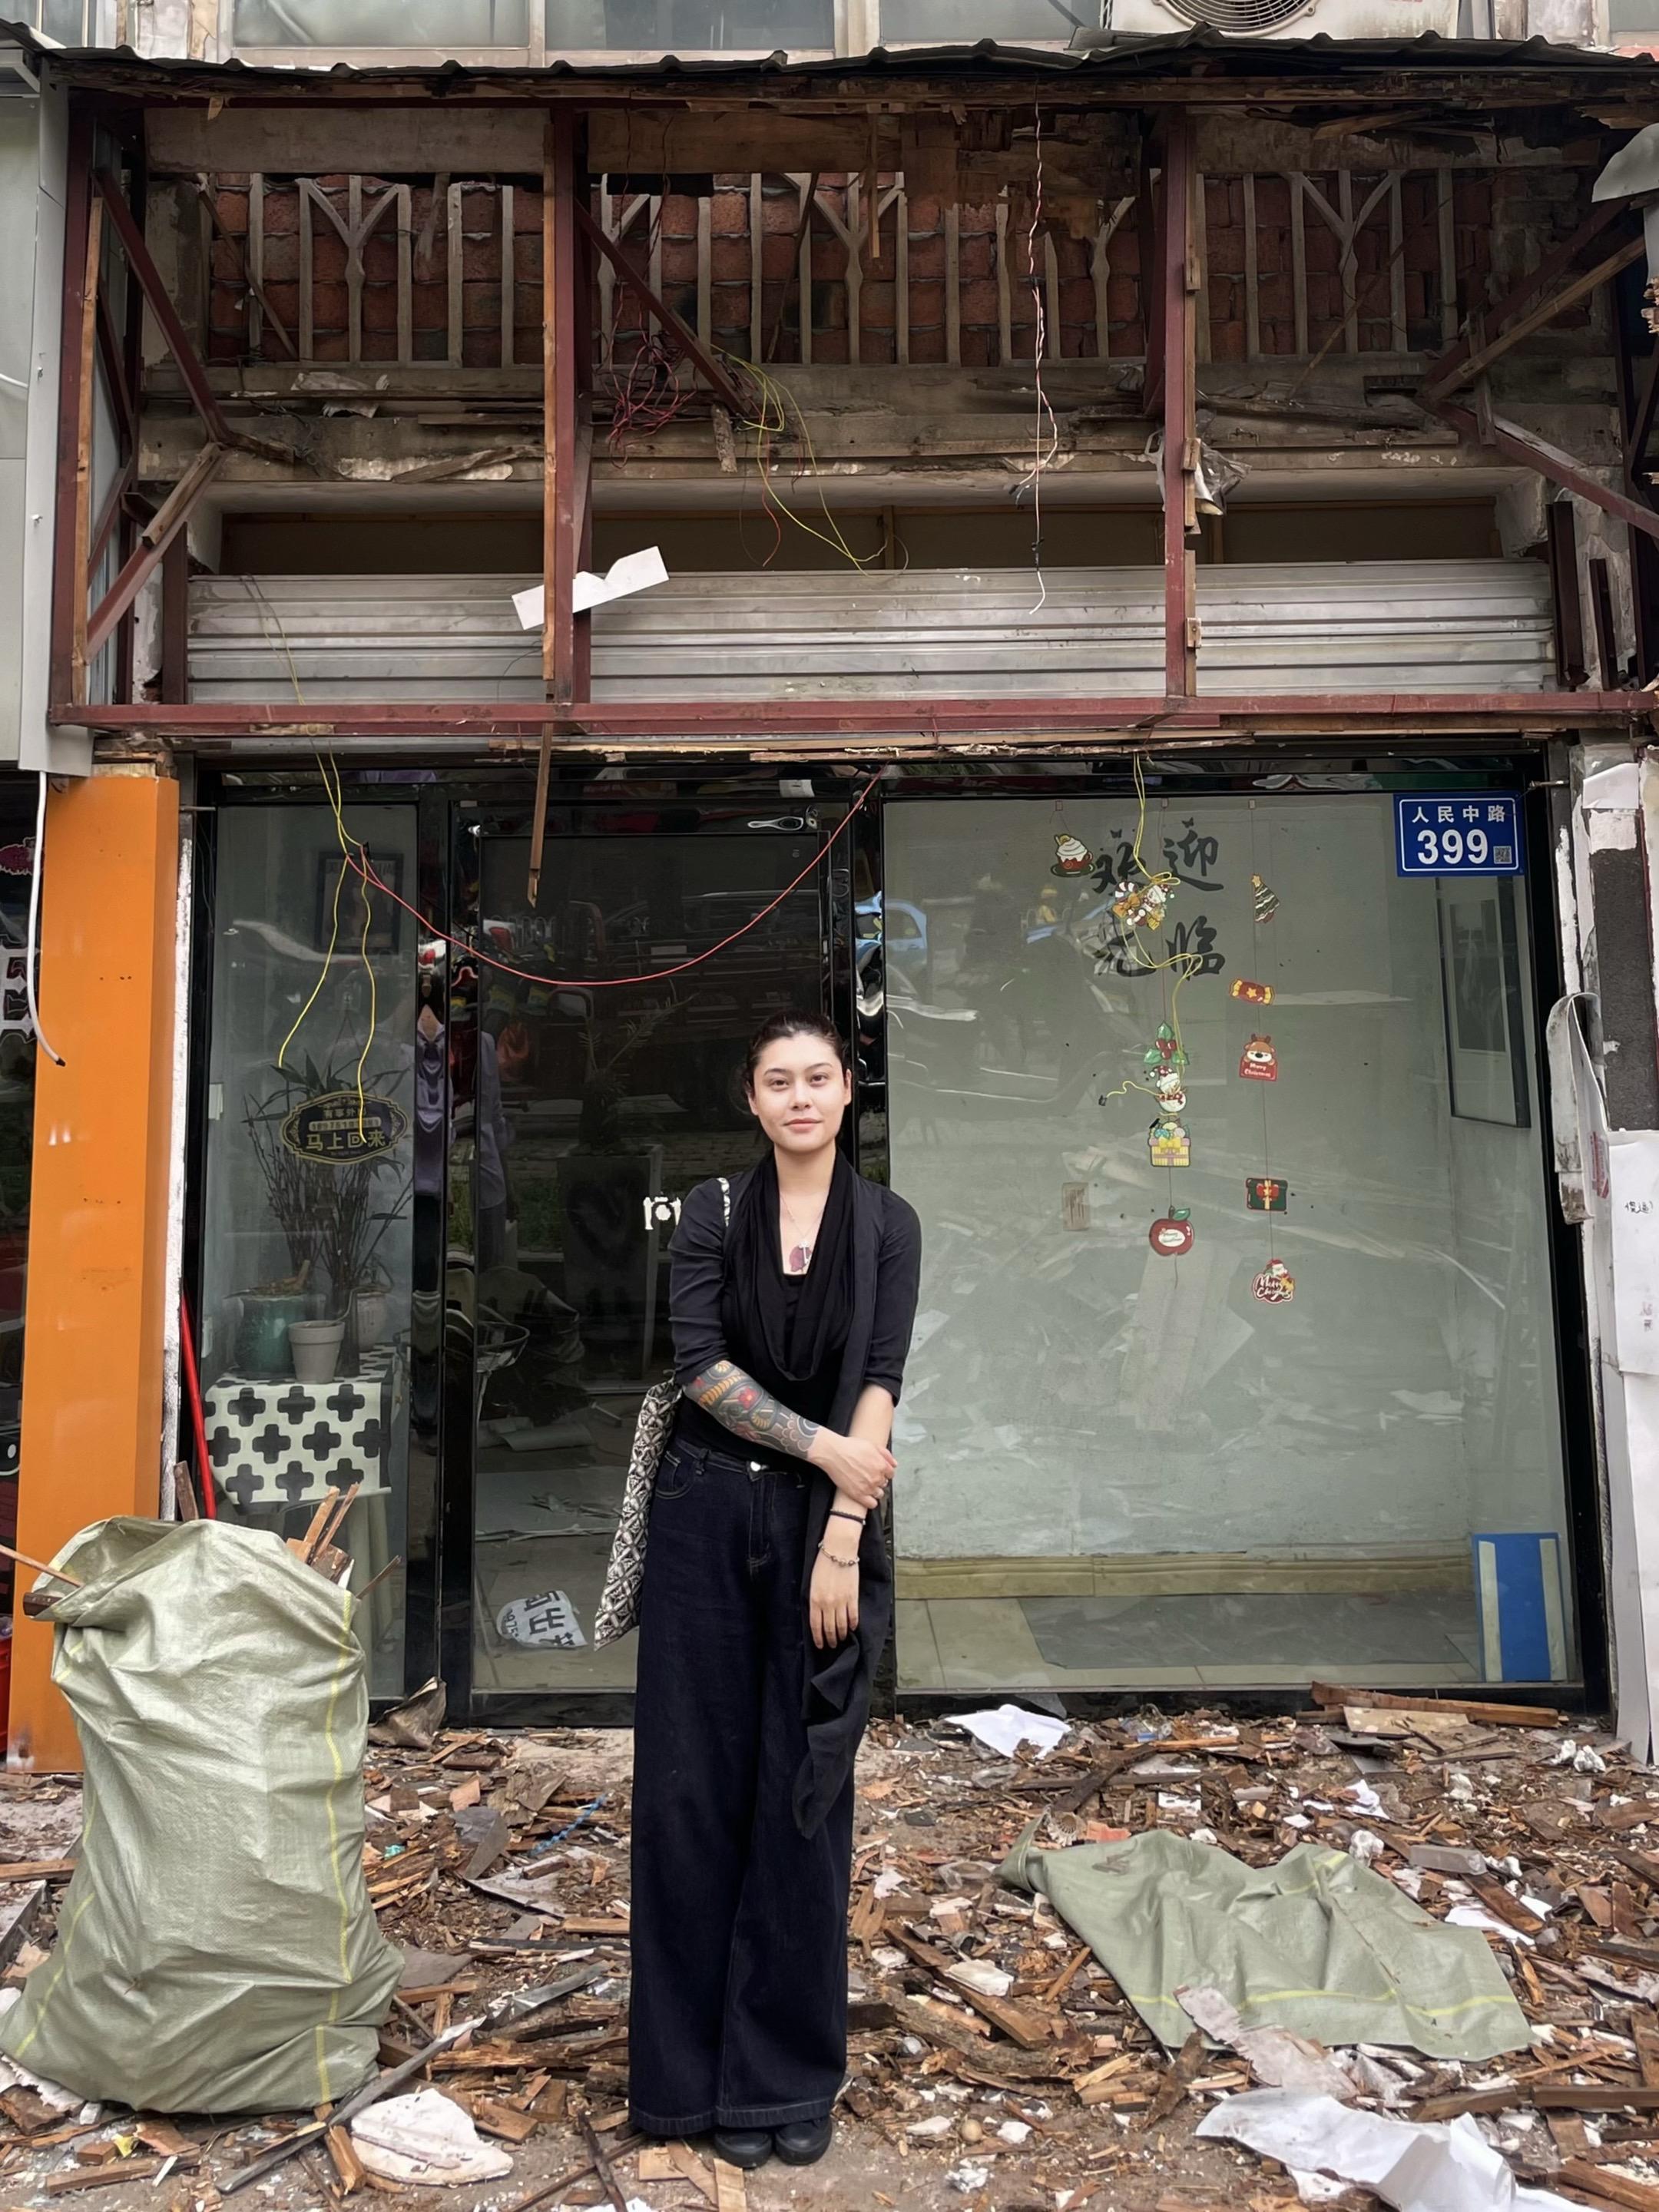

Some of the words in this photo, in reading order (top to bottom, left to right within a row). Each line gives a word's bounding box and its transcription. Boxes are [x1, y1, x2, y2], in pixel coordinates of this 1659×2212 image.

[1412, 804, 1505, 823] 人民中路
[1417, 829, 1488, 865] 399
